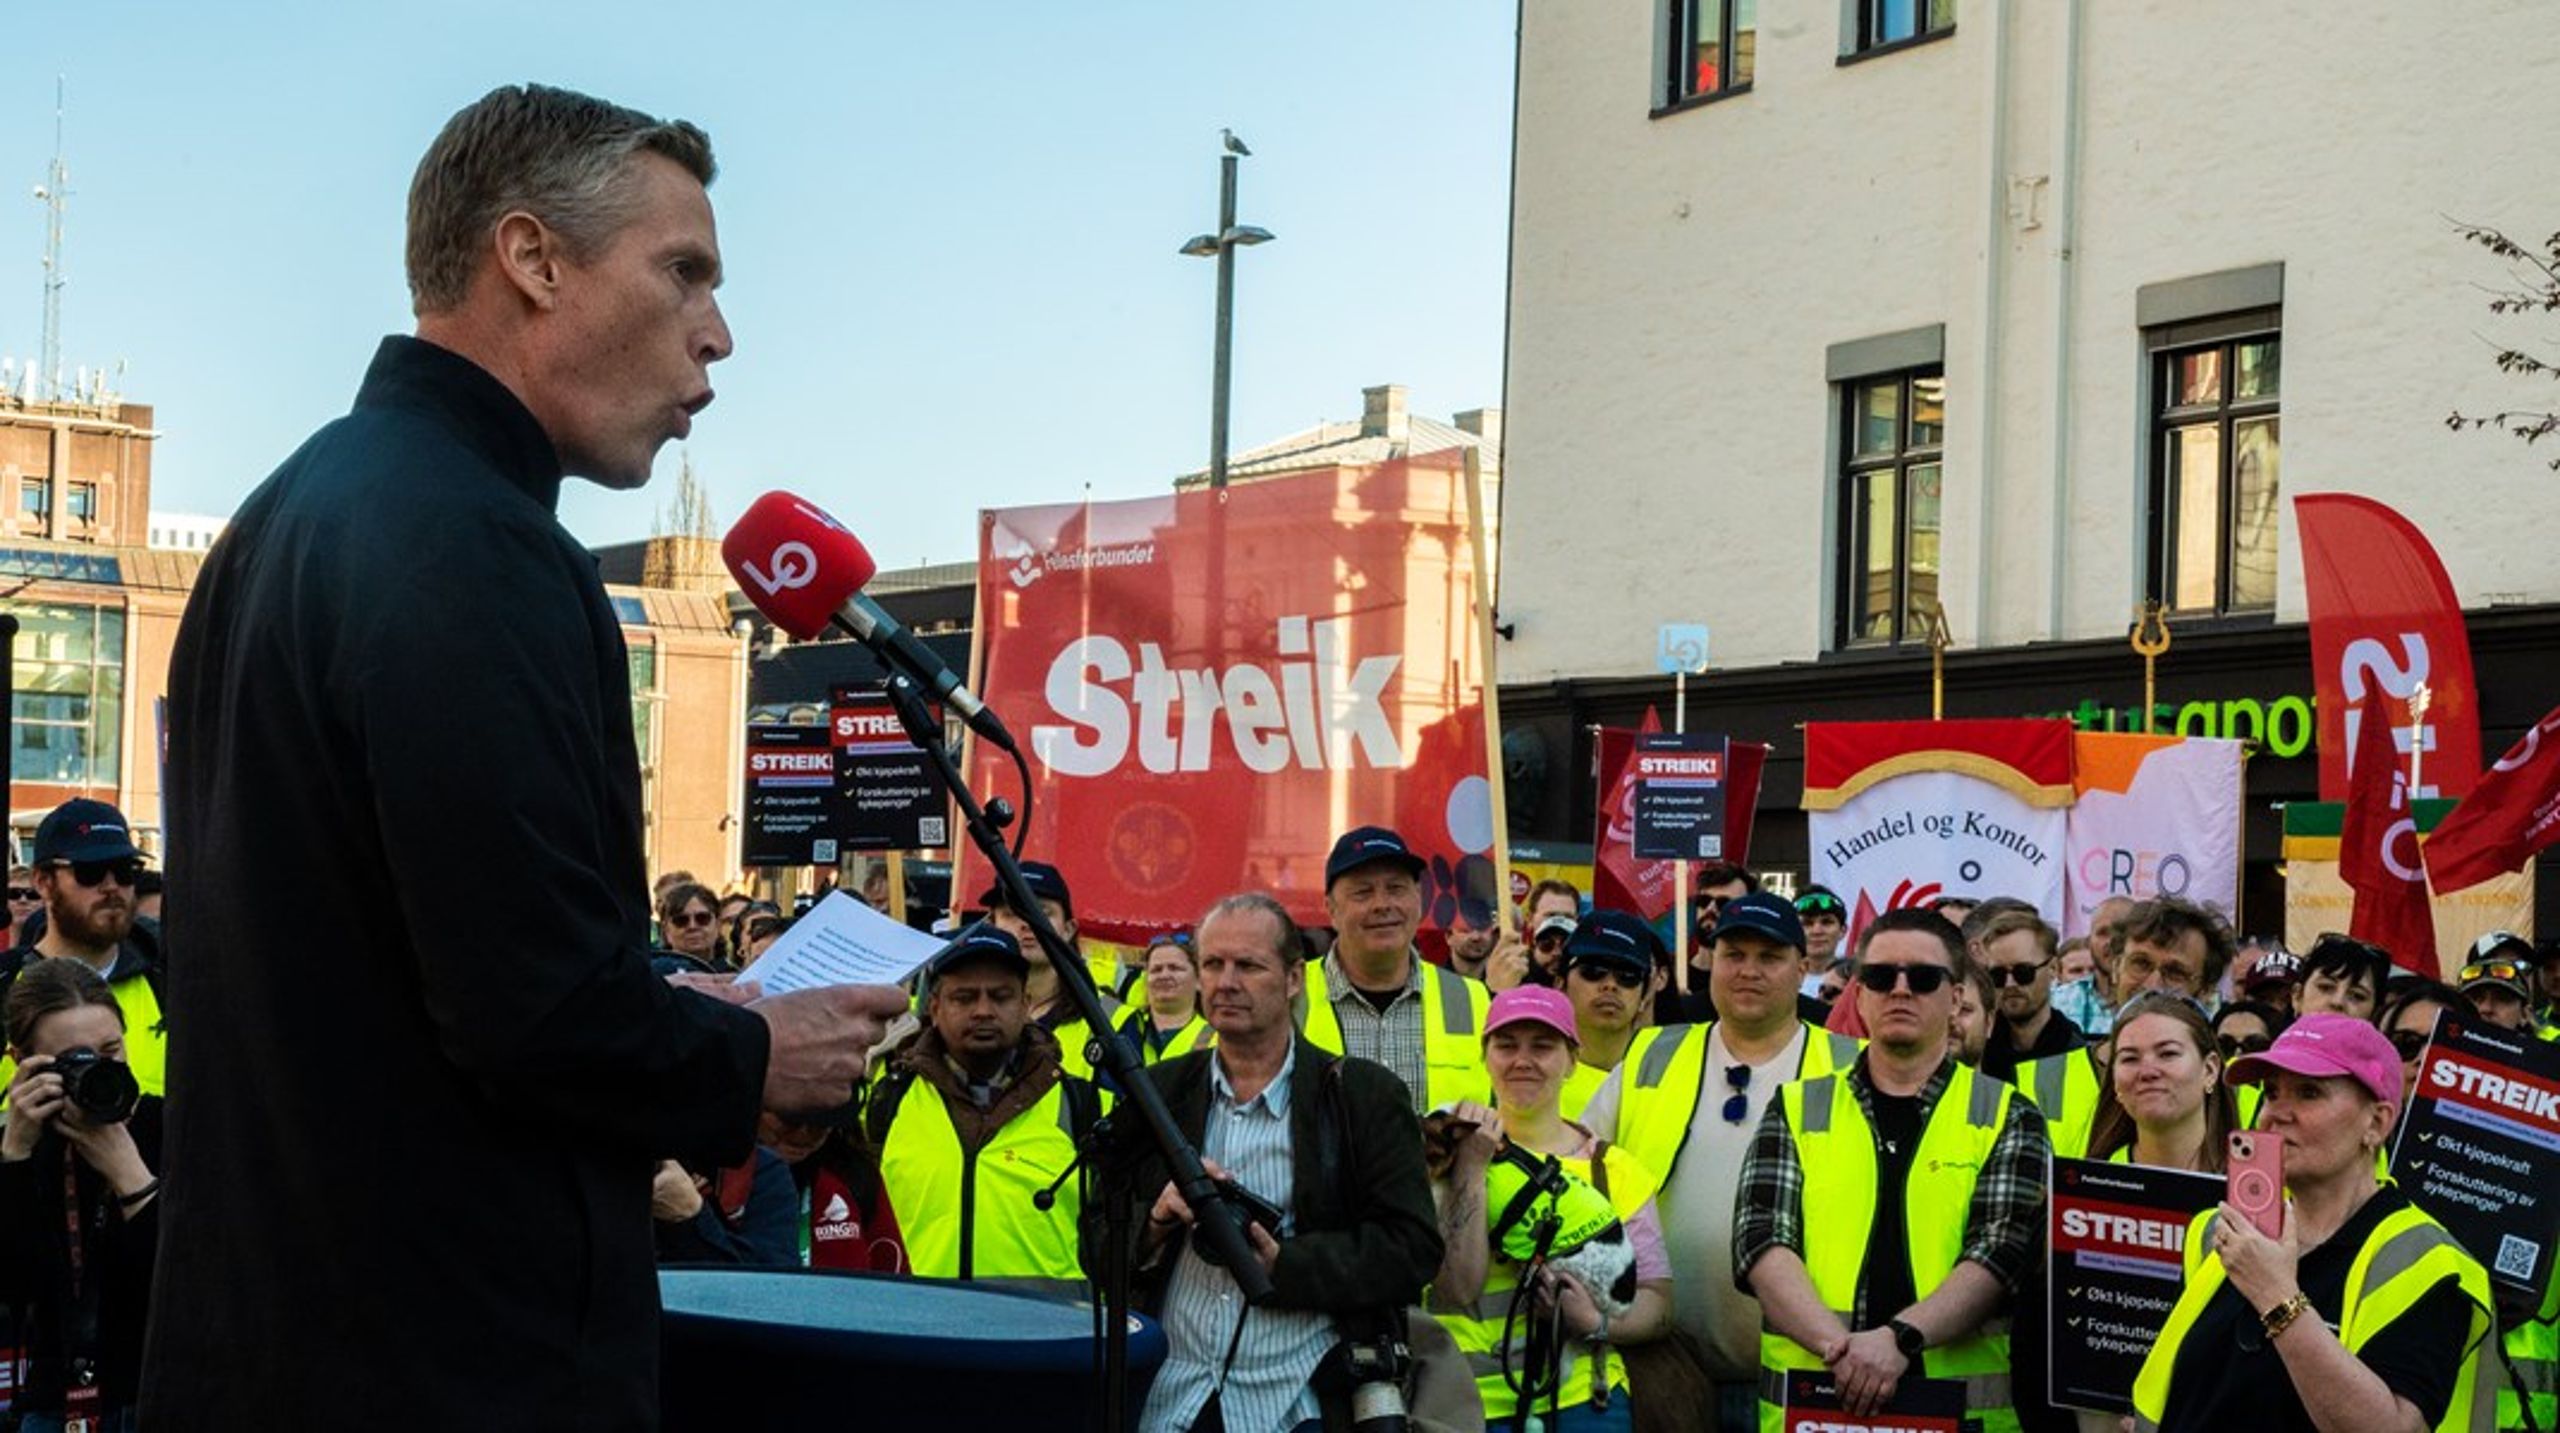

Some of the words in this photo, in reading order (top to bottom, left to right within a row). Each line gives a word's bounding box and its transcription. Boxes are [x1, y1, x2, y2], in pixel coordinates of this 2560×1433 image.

[741, 540, 817, 596] LO
[1031, 615, 1402, 778] Streik
[837, 715, 907, 736] STRE
[1640, 757, 1716, 774] STREIK!
[1825, 810, 1915, 869] Handel
[1923, 811, 1954, 840] og
[1963, 810, 2048, 868] Kontor
[2080, 848, 2191, 897] CREO
[2463, 1142, 2532, 1176] kjøpekraft
[2422, 1180, 2503, 1213] sykepenger
[2427, 1162, 2517, 1203] Forskuttering
[2518, 1193, 2537, 1208] av
